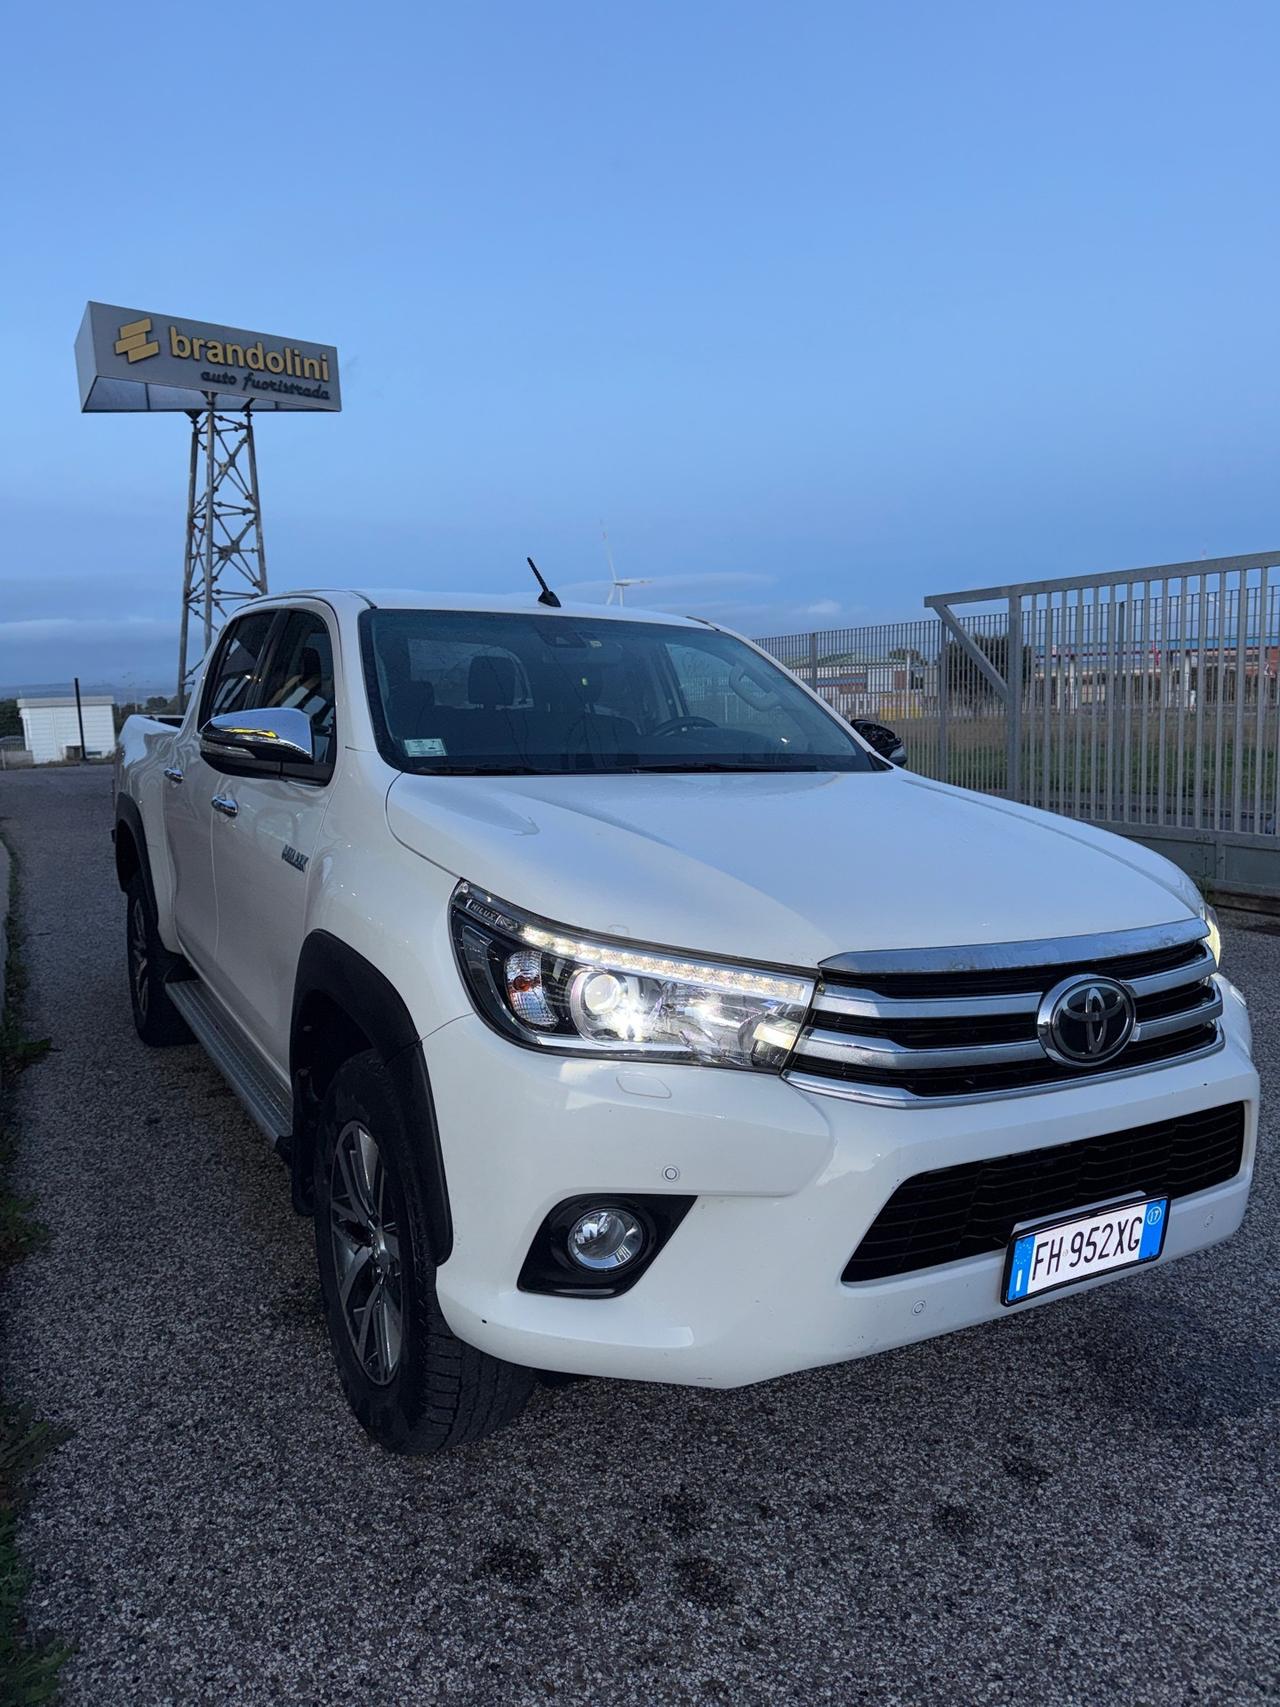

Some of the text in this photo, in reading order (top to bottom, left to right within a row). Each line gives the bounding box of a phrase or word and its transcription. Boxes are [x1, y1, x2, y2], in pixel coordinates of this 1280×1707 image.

[169, 326, 330, 382] brandolini
[201, 371, 331, 400] auto fuoristrada
[1032, 1236, 1064, 1281] FH
[1069, 1217, 1143, 1268] 952XG
